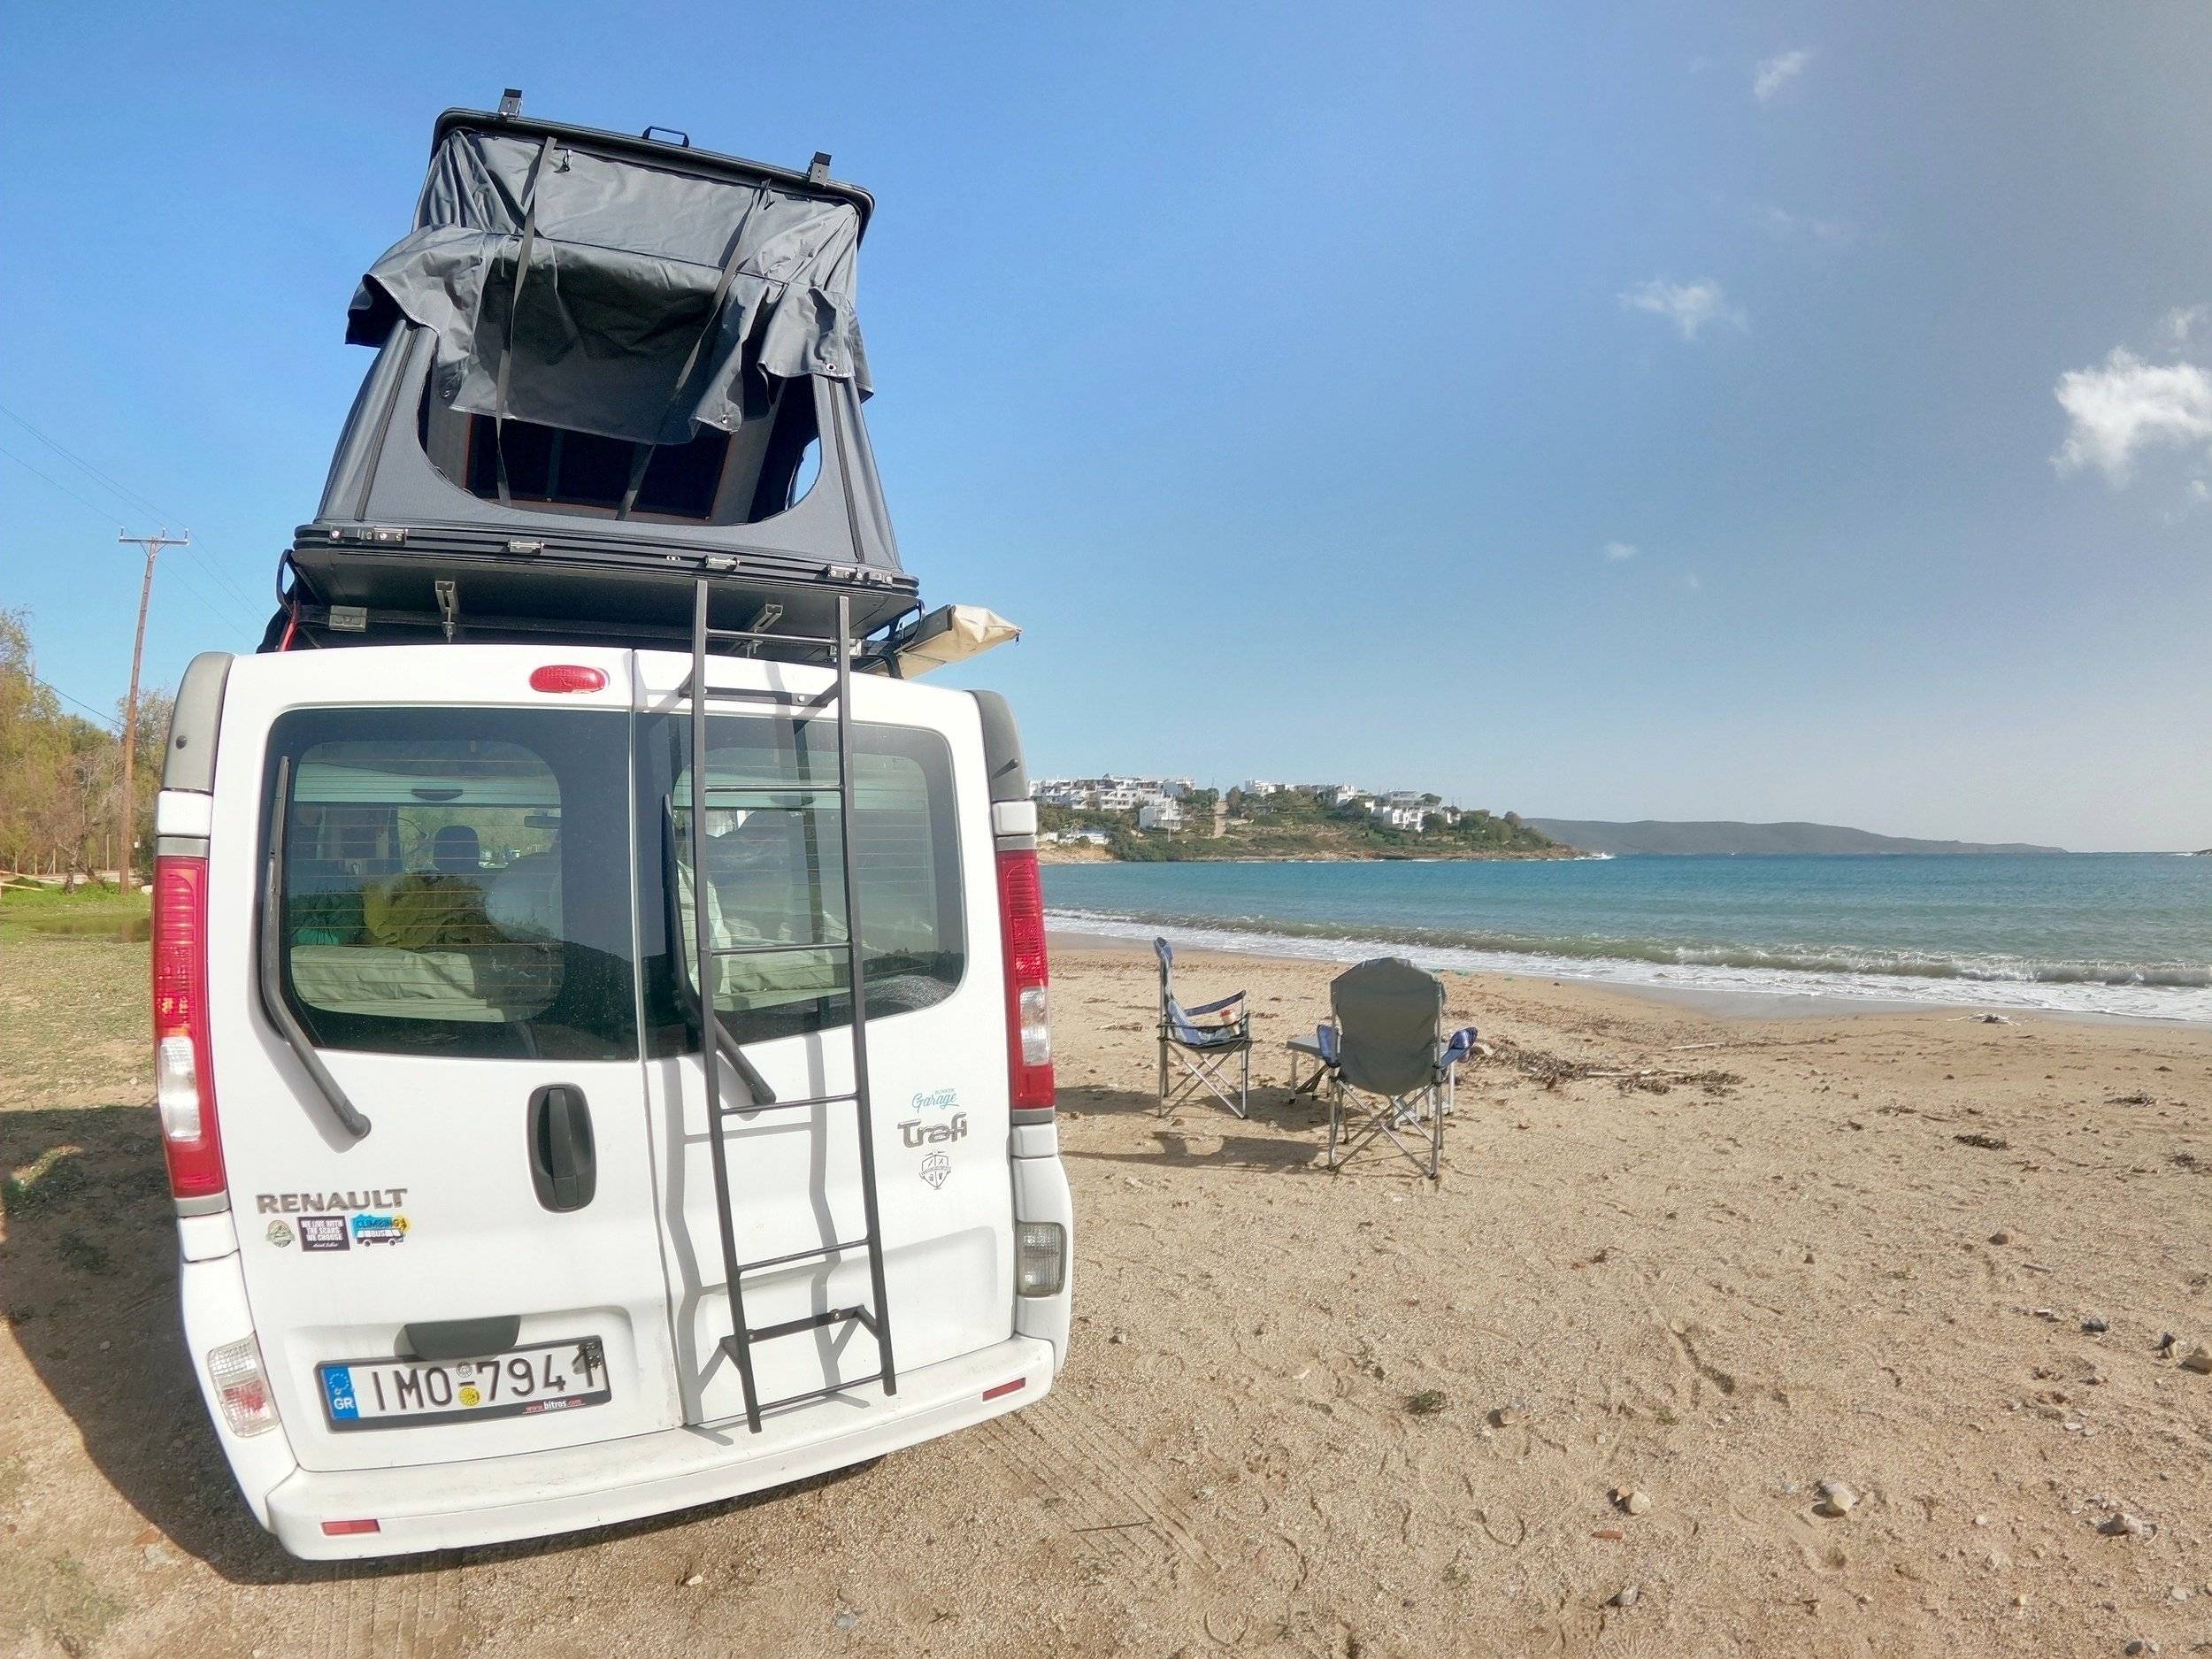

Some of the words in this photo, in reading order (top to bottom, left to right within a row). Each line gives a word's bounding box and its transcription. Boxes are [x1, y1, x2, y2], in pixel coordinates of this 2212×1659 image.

[911, 1093, 959, 1113] Garage
[255, 1188, 408, 1214] RENAULT
[334, 1398, 354, 1411] GR
